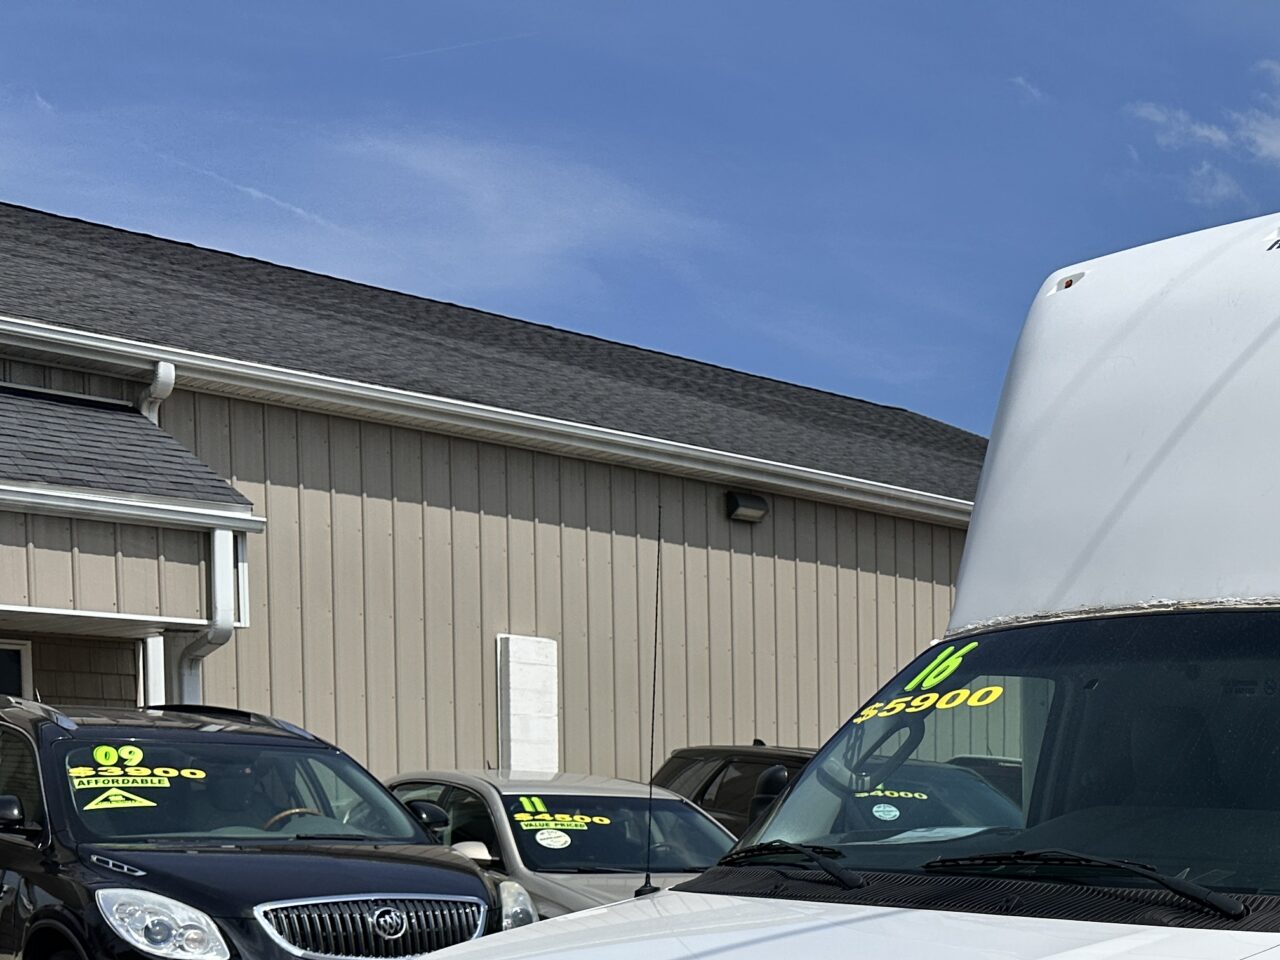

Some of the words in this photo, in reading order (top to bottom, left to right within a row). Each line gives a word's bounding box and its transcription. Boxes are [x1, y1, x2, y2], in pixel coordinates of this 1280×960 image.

[904, 641, 978, 691] 16
[853, 686, 1003, 724] $5900
[93, 745, 144, 766] 09
[68, 766, 206, 779] $3900
[77, 778, 165, 787] AFFORDABLE
[519, 796, 547, 812] 11
[513, 812, 611, 825] $4500
